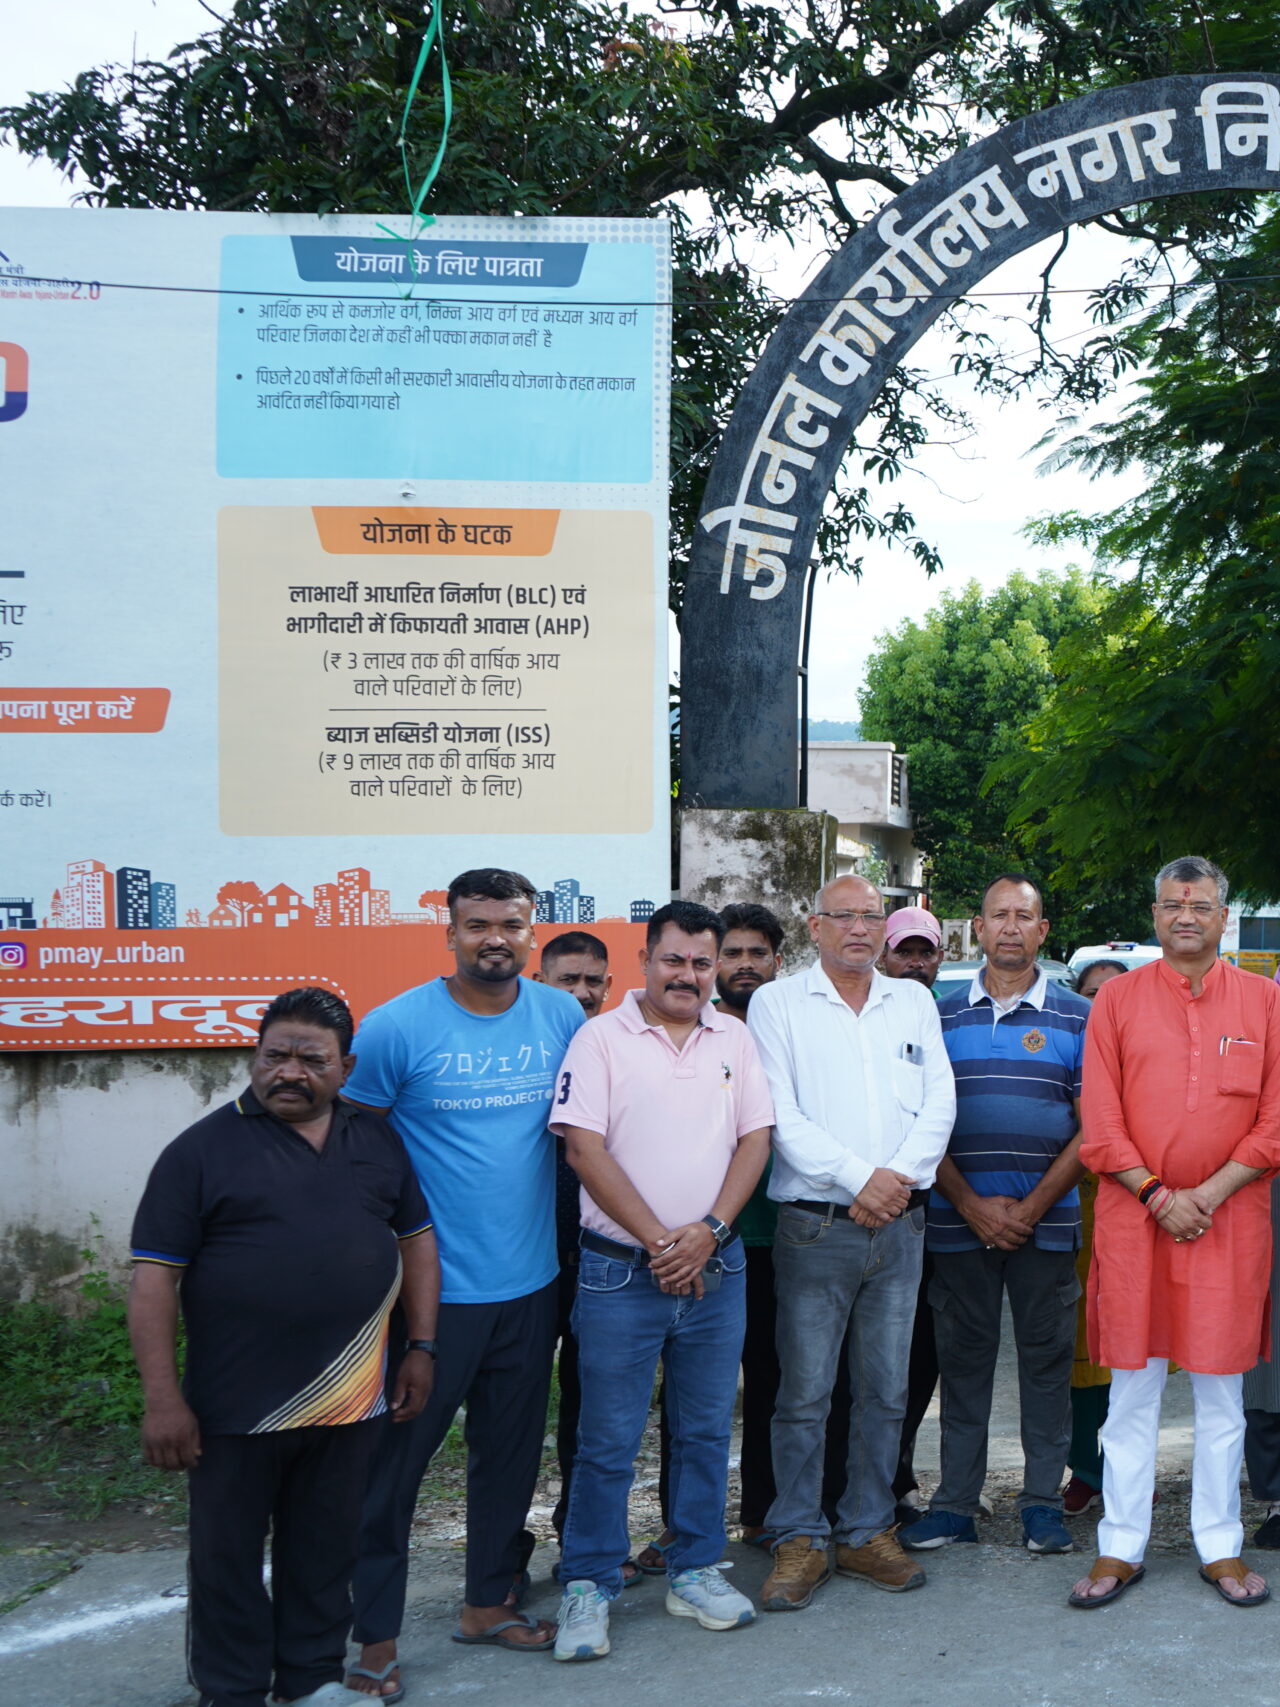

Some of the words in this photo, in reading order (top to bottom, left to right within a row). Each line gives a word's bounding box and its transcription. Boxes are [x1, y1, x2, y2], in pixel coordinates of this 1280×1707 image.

[799, 165, 1027, 387] कार्यालय
[1015, 109, 1183, 201] नगर
[335, 247, 406, 274] योजना
[408, 249, 432, 275] के
[436, 250, 479, 276] लिए
[484, 256, 544, 278] पात्रता
[258, 299, 301, 319] आर्थिक
[306, 303, 328, 319] रूप
[332, 301, 345, 319] से
[349, 301, 397, 319] कमजोर
[467, 306, 493, 321] आय
[498, 304, 517, 323] वर्ग
[521, 307, 540, 323] एवं
[543, 309, 585, 325] मध्यम
[588, 311, 615, 326] आय
[619, 308, 638, 327] वर्ग
[256, 324, 301, 343] परिवार
[304, 324, 347, 343] जिनका
[350, 325, 369, 343] देश
[372, 326, 386, 343] में
[387, 325, 414, 344] कहीं
[415, 325, 431, 344] भी
[433, 329, 467, 345] पक्का
[469, 331, 510, 346] मकान
[512, 329, 540, 347] नहीं
[543, 329, 553, 348] है
[256, 366, 292, 385] पिछले
[294, 370, 310, 385] 20
[336, 366, 350, 385] में
[350, 367, 383, 386] किसी
[384, 367, 400, 386] भी
[402, 368, 453, 387] सरकारी
[455, 369, 509, 389] आवासीय
[512, 370, 554, 390] योजना
[555, 372, 568, 390] के
[569, 376, 595, 391] तहत
[597, 377, 637, 391] मकान
[256, 391, 301, 409] आवंटित
[303, 391, 330, 409] नहीं
[330, 391, 360, 409] किया
[361, 395, 385, 410] गया
[387, 391, 401, 410] हो
[360, 517, 431, 544] योजना
[435, 518, 458, 544] के
[461, 524, 513, 545] घटक
[288, 581, 359, 603] लाभार्थी
[364, 582, 435, 604] आधारित
[439, 582, 502, 604] निर्माण
[506, 584, 556, 608] (BLC)
[561, 584, 587, 605] एवं
[286, 612, 363, 634] भागीदारी
[368, 613, 387, 634] में
[389, 612, 468, 634] किफायती
[473, 616, 529, 635] आवास
[535, 615, 589, 639] (AHP)
[347, 653, 357, 670] 3
[364, 652, 407, 670] लाख
[411, 652, 438, 670] तक
[443, 647, 465, 670] की
[469, 646, 521, 670] वार्षिक
[526, 652, 560, 670] आय
[353, 675, 388, 696] वाले
[392, 675, 457, 697] परिवारों
[460, 675, 477, 696] के
[481, 675, 522, 699] लिए)
[52, 701, 92, 726] पूरा
[96, 695, 137, 720] करें
[325, 726, 370, 743] ब्याज
[373, 721, 439, 744] सब्सिडी
[443, 721, 501, 743] योजना
[506, 723, 551, 747] (ISS)
[343, 753, 354, 770] 9
[359, 753, 402, 770] लाख
[406, 753, 434, 770] तक
[439, 748, 460, 770] की
[465, 747, 517, 770] वार्षिक
[521, 753, 556, 770] आय
[350, 776, 385, 797] वाले
[388, 776, 453, 797] परिवारों
[461, 775, 477, 797] के
[482, 775, 522, 799] लिए)
[39, 941, 185, 969] pmay_urban
[433, 1097, 482, 1111] TOKYO
[485, 1089, 545, 1108] PROJECT
[558, 1072, 572, 1104] 3
